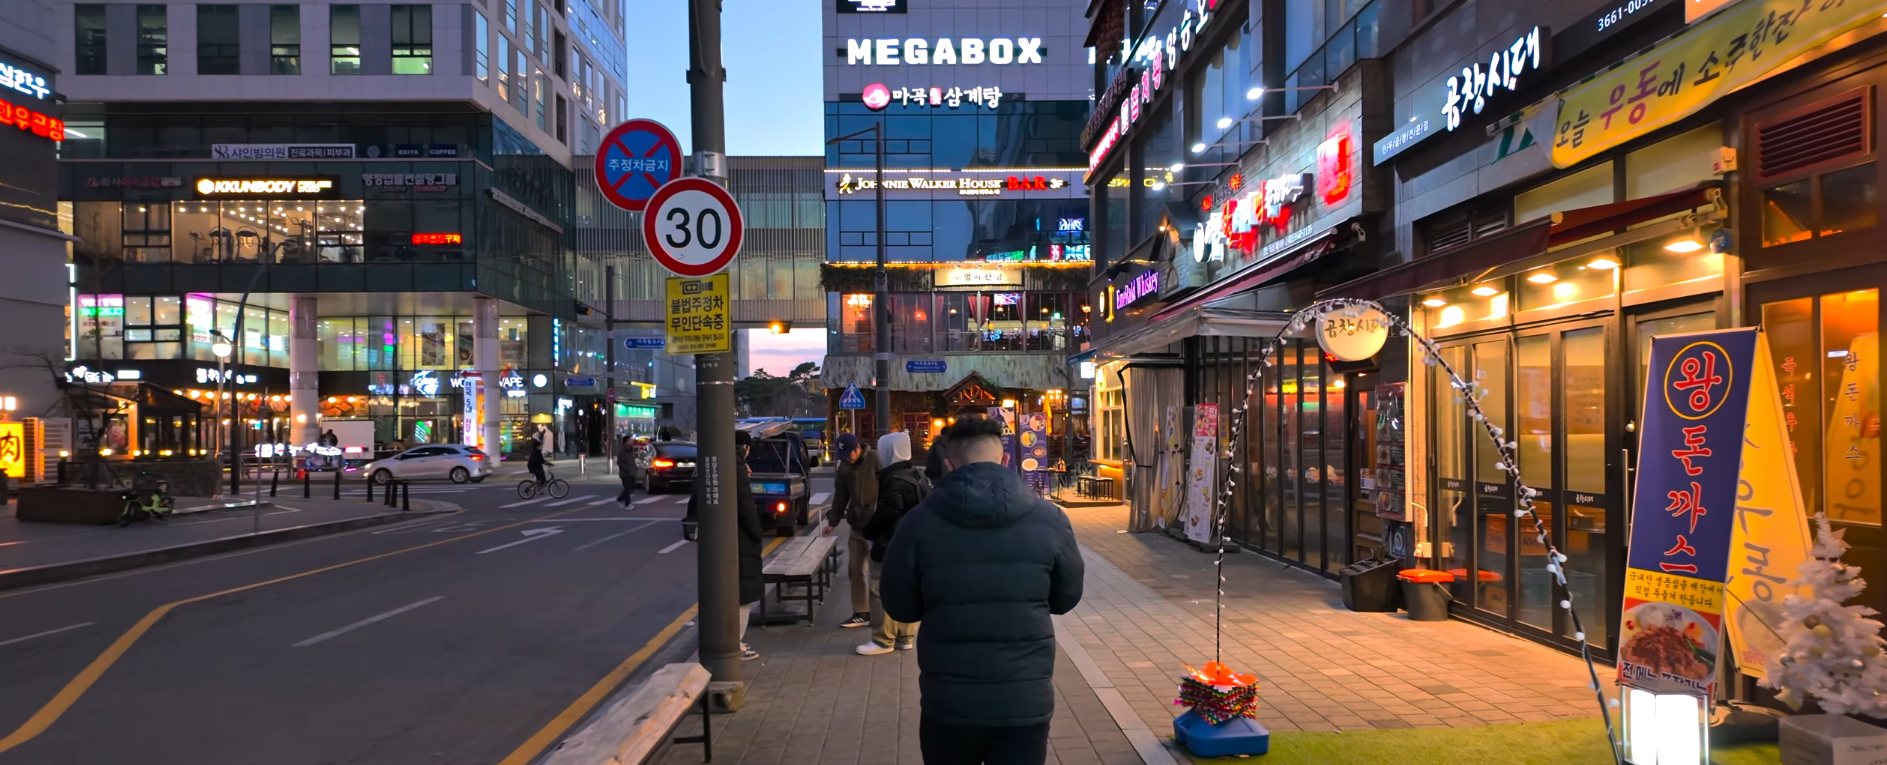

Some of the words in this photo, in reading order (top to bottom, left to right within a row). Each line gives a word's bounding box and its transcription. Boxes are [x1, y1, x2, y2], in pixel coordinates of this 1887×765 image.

[847, 38, 1042, 65] MEGABOX
[1441, 26, 1540, 131] 곱창시대
[892, 87, 927, 106] 마곡
[944, 87, 1003, 109] 삼계탕
[1556, 109, 1591, 149] 오늘
[1600, 60, 1687, 131] 우동에
[231, 147, 286, 159] 샤인빔의원
[608, 158, 669, 172] 주정차금지
[214, 180, 296, 193] KKUNBODY
[908, 178, 957, 190] WALKER
[959, 178, 1003, 190] HOUSE
[1007, 177, 1048, 190] BAR
[1050, 179, 1064, 188] 3F
[666, 207, 722, 250] 30
[671, 295, 724, 314] 불법주정차
[671, 314, 724, 332] 무인단속중
